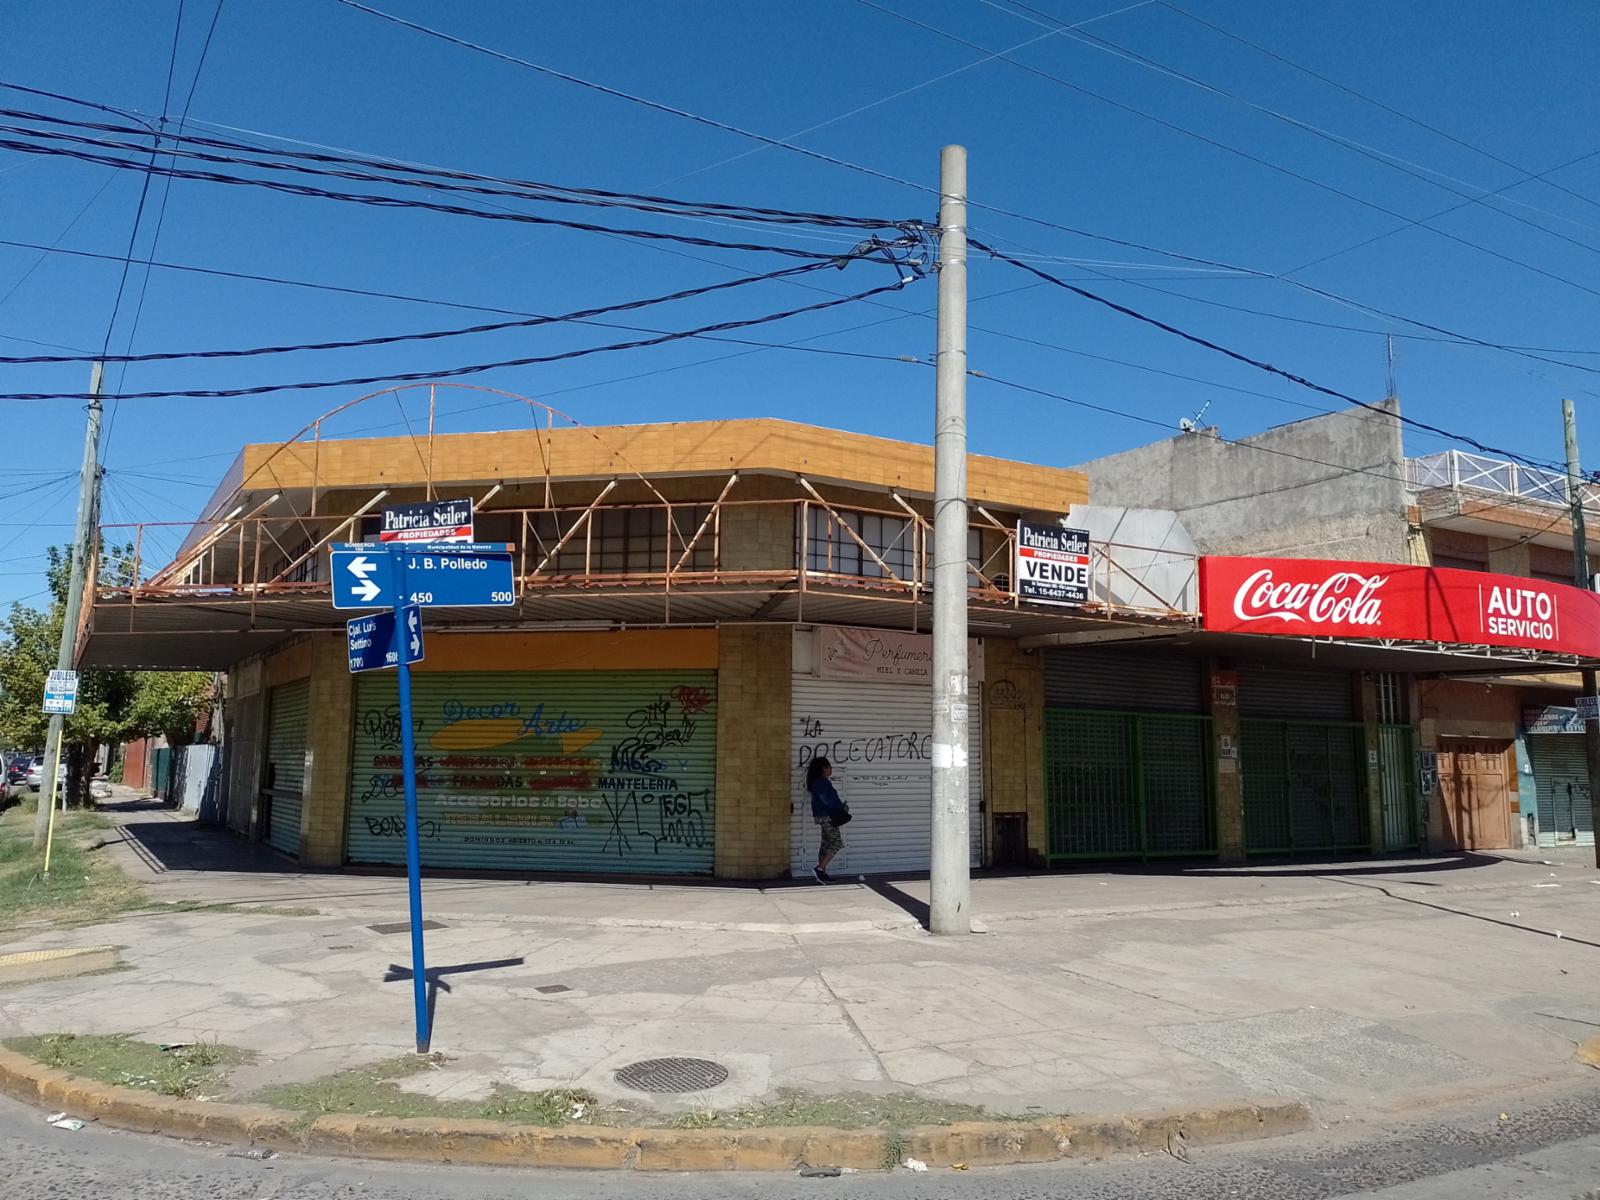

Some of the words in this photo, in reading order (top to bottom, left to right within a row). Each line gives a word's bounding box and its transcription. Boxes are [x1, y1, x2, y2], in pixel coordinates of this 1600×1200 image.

[385, 510, 430, 529] Patricia
[433, 506, 467, 526] Seiler
[398, 528, 456, 539] PROPIEDADES
[1023, 527, 1058, 549] Patricia
[1061, 533, 1087, 553] Seiler
[408, 558, 420, 569] J.
[424, 558, 437, 569] B.
[441, 558, 488, 569] Polledo
[1034, 550, 1078, 562] PROPIEDADES
[1026, 560, 1086, 584] VENDE
[410, 592, 433, 603] 450
[491, 591, 512, 602] 500
[1024, 586, 1037, 594] Tel.
[1233, 569, 1389, 625] Coca-Cola
[1488, 586, 1552, 620] AUTO
[363, 621, 376, 633] Luis
[1488, 617, 1553, 640] SERVICIO
[864, 639, 933, 665] Perfumer
[443, 699, 520, 724] Decor
[517, 702, 587, 736] Arte
[598, 777, 678, 790] MANTELERIA
[434, 794, 541, 808] Accesorios
